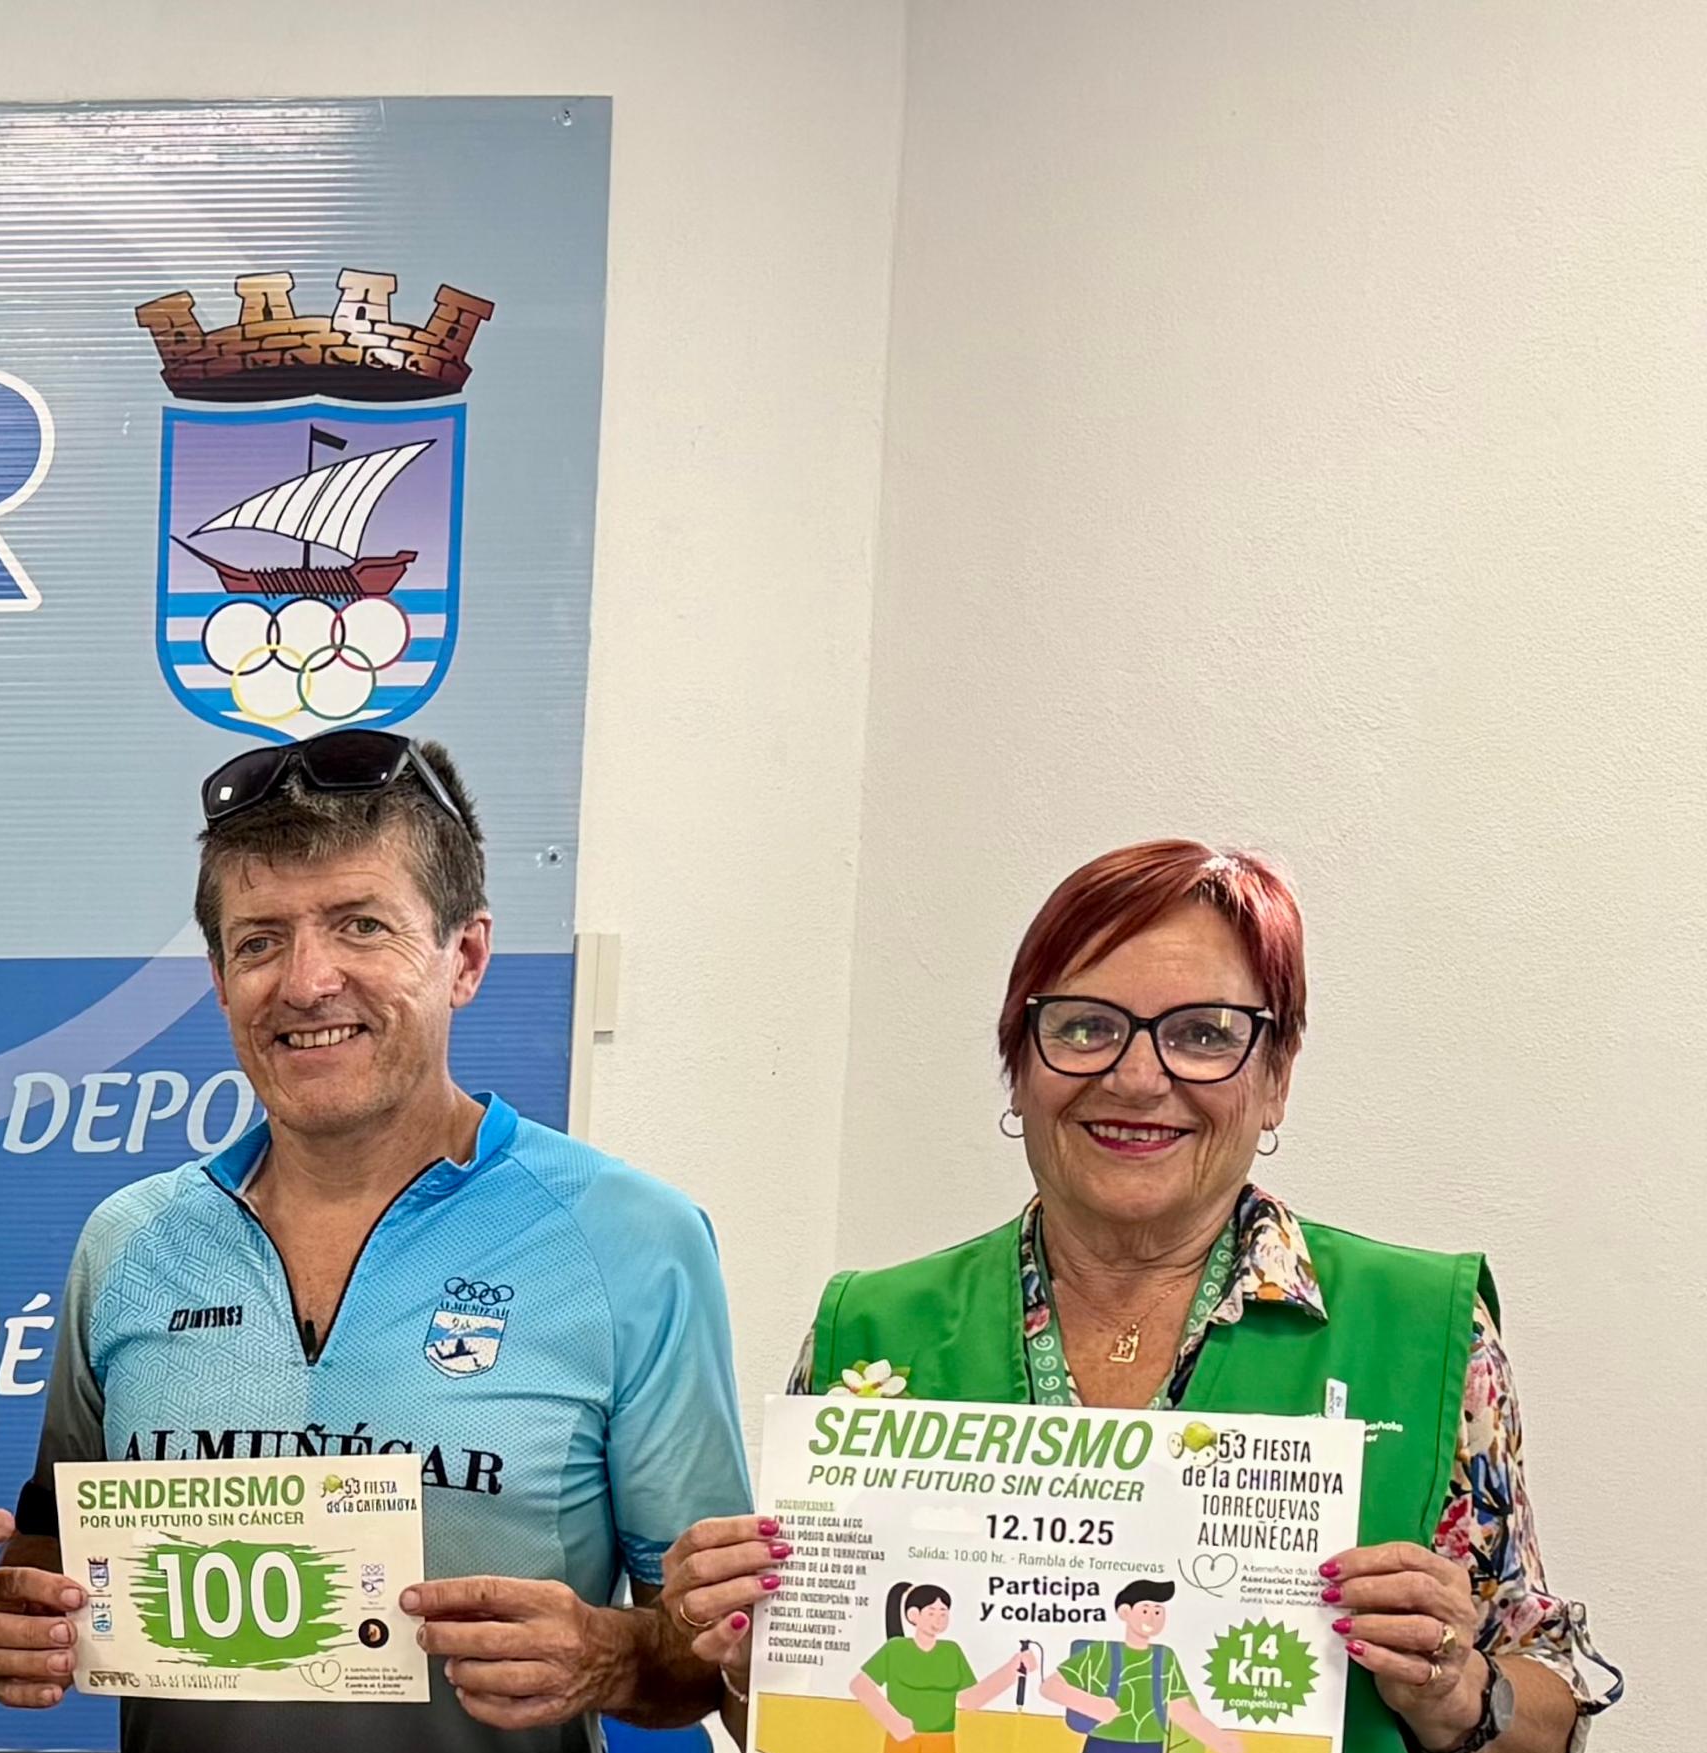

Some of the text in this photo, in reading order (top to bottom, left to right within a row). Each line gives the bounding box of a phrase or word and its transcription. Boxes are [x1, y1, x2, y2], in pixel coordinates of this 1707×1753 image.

[3, 1069, 260, 1156] DEPO
[809, 1406, 1154, 1471] SENDERISMO
[1219, 1432, 1311, 1463] 53 FIESTA
[76, 1475, 305, 1510] SENDERISMO
[344, 1478, 397, 1494] 53 FIESTA
[808, 1465, 1144, 1502] POR UN FUTURO SIN CÁNCER
[1183, 1466, 1344, 1495] de la CHIRIMOYA
[80, 1510, 304, 1529] POR UN FUTURO SIN CÁNCER
[1202, 1494, 1320, 1522] TORRECUEVAS
[987, 1514, 1115, 1545] 12.10.25
[1198, 1518, 1318, 1553] ALMUÑÉCAR
[908, 1546, 1164, 1573] Salida: 10:00 hr. Rambla de Torrecuevas
[157, 1551, 302, 1639] 100
[989, 1576, 1100, 1601] Participa
[980, 1602, 1106, 1622] y colabora
[1239, 1634, 1278, 1659] 14
[1228, 1660, 1292, 1688] Km.
[1229, 1698, 1288, 1710] competitiva
[1253, 1689, 1267, 1698] No
